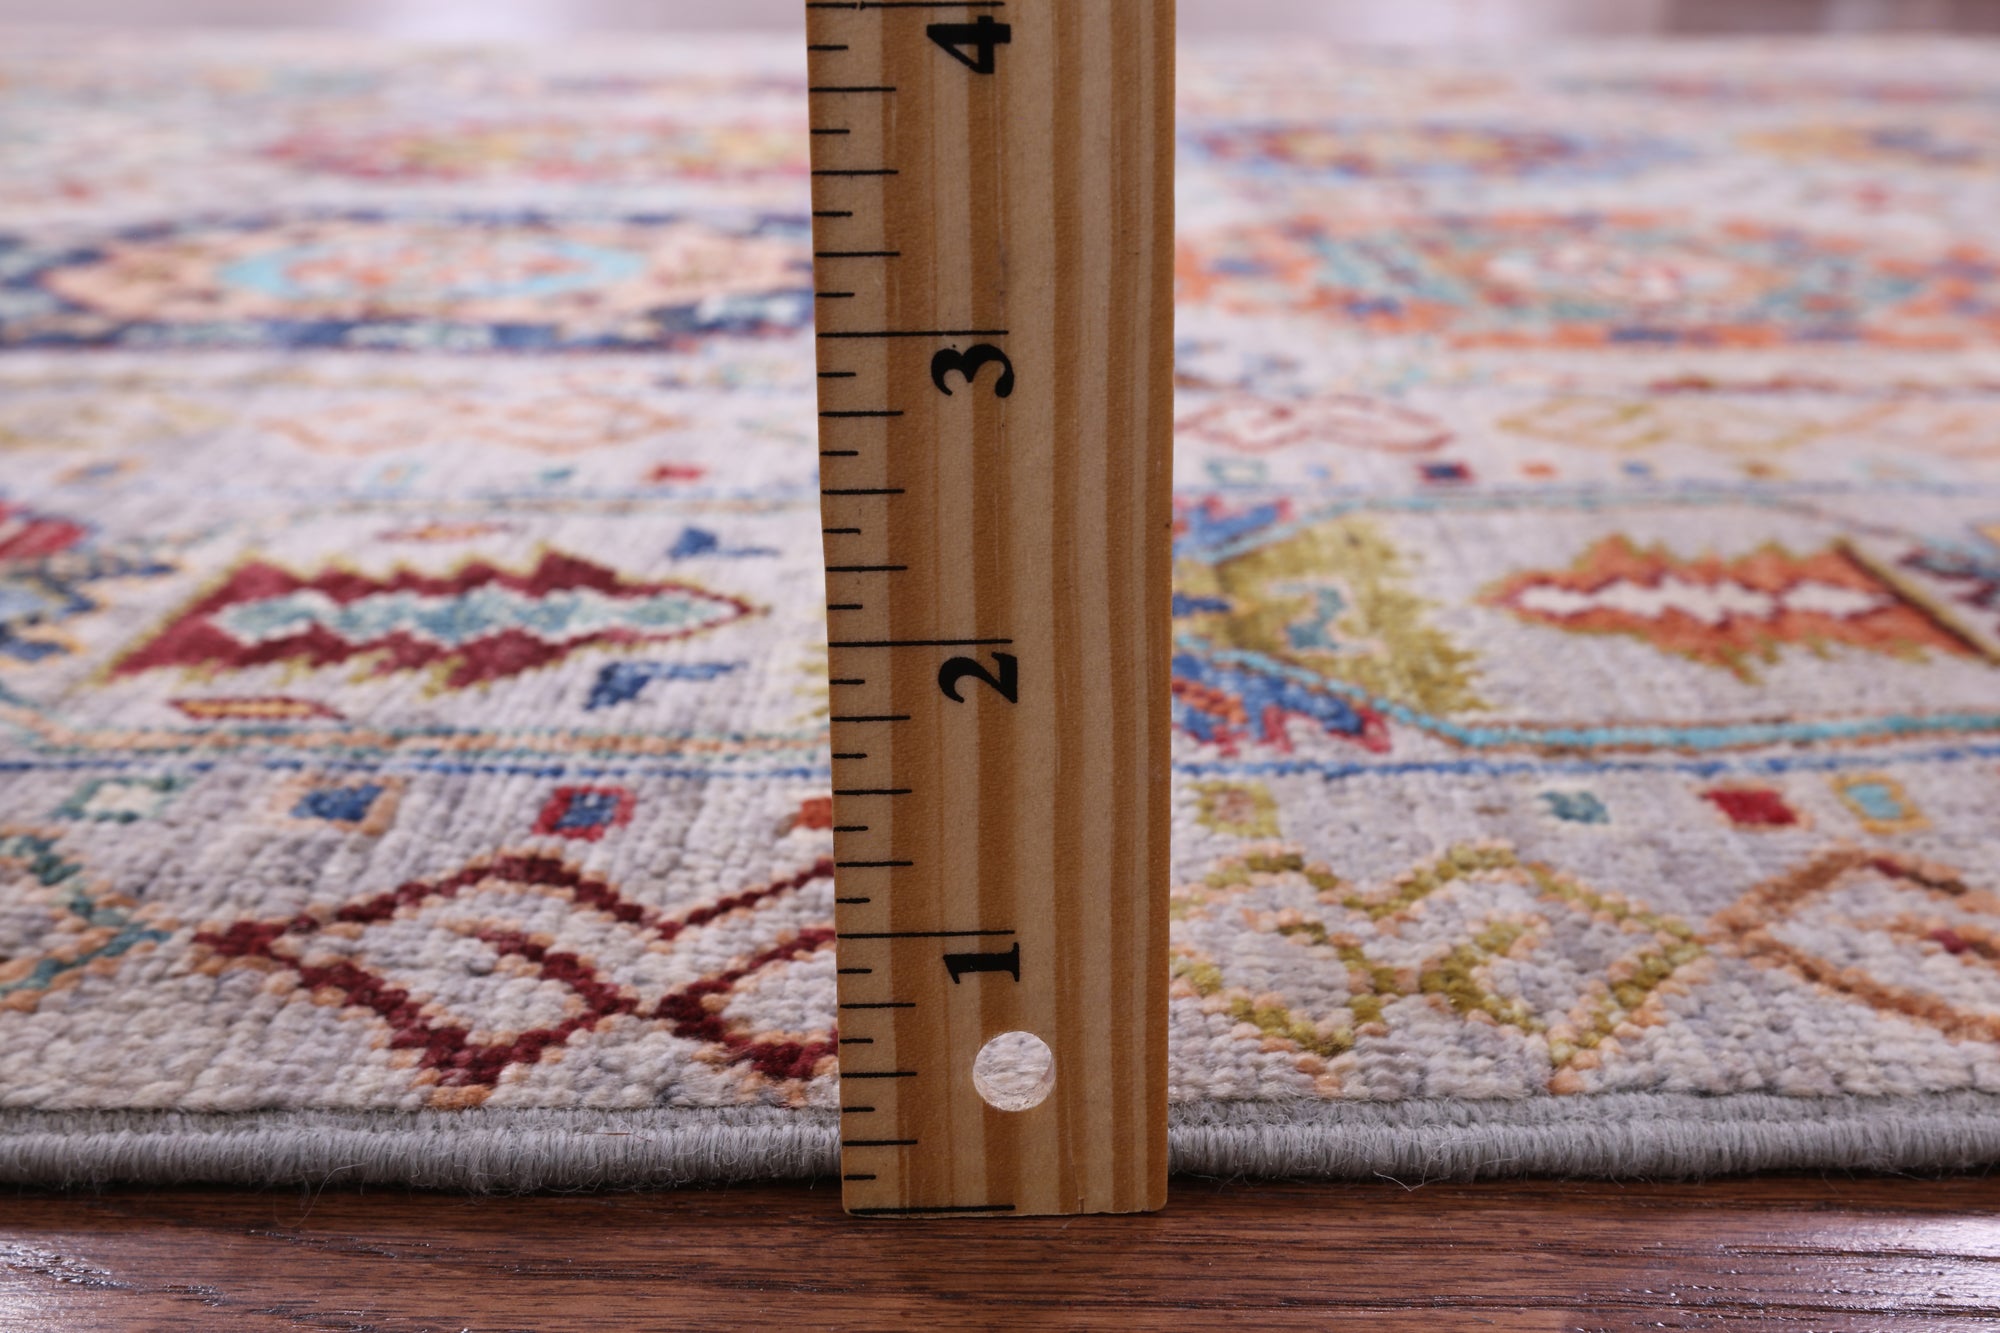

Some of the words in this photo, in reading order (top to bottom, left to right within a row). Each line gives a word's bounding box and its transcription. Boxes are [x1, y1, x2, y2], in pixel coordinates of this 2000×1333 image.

[926, 15, 1011, 74] 4
[931, 343, 1014, 398] 3
[938, 652, 1018, 704] 2
[943, 942, 1020, 984] 1
